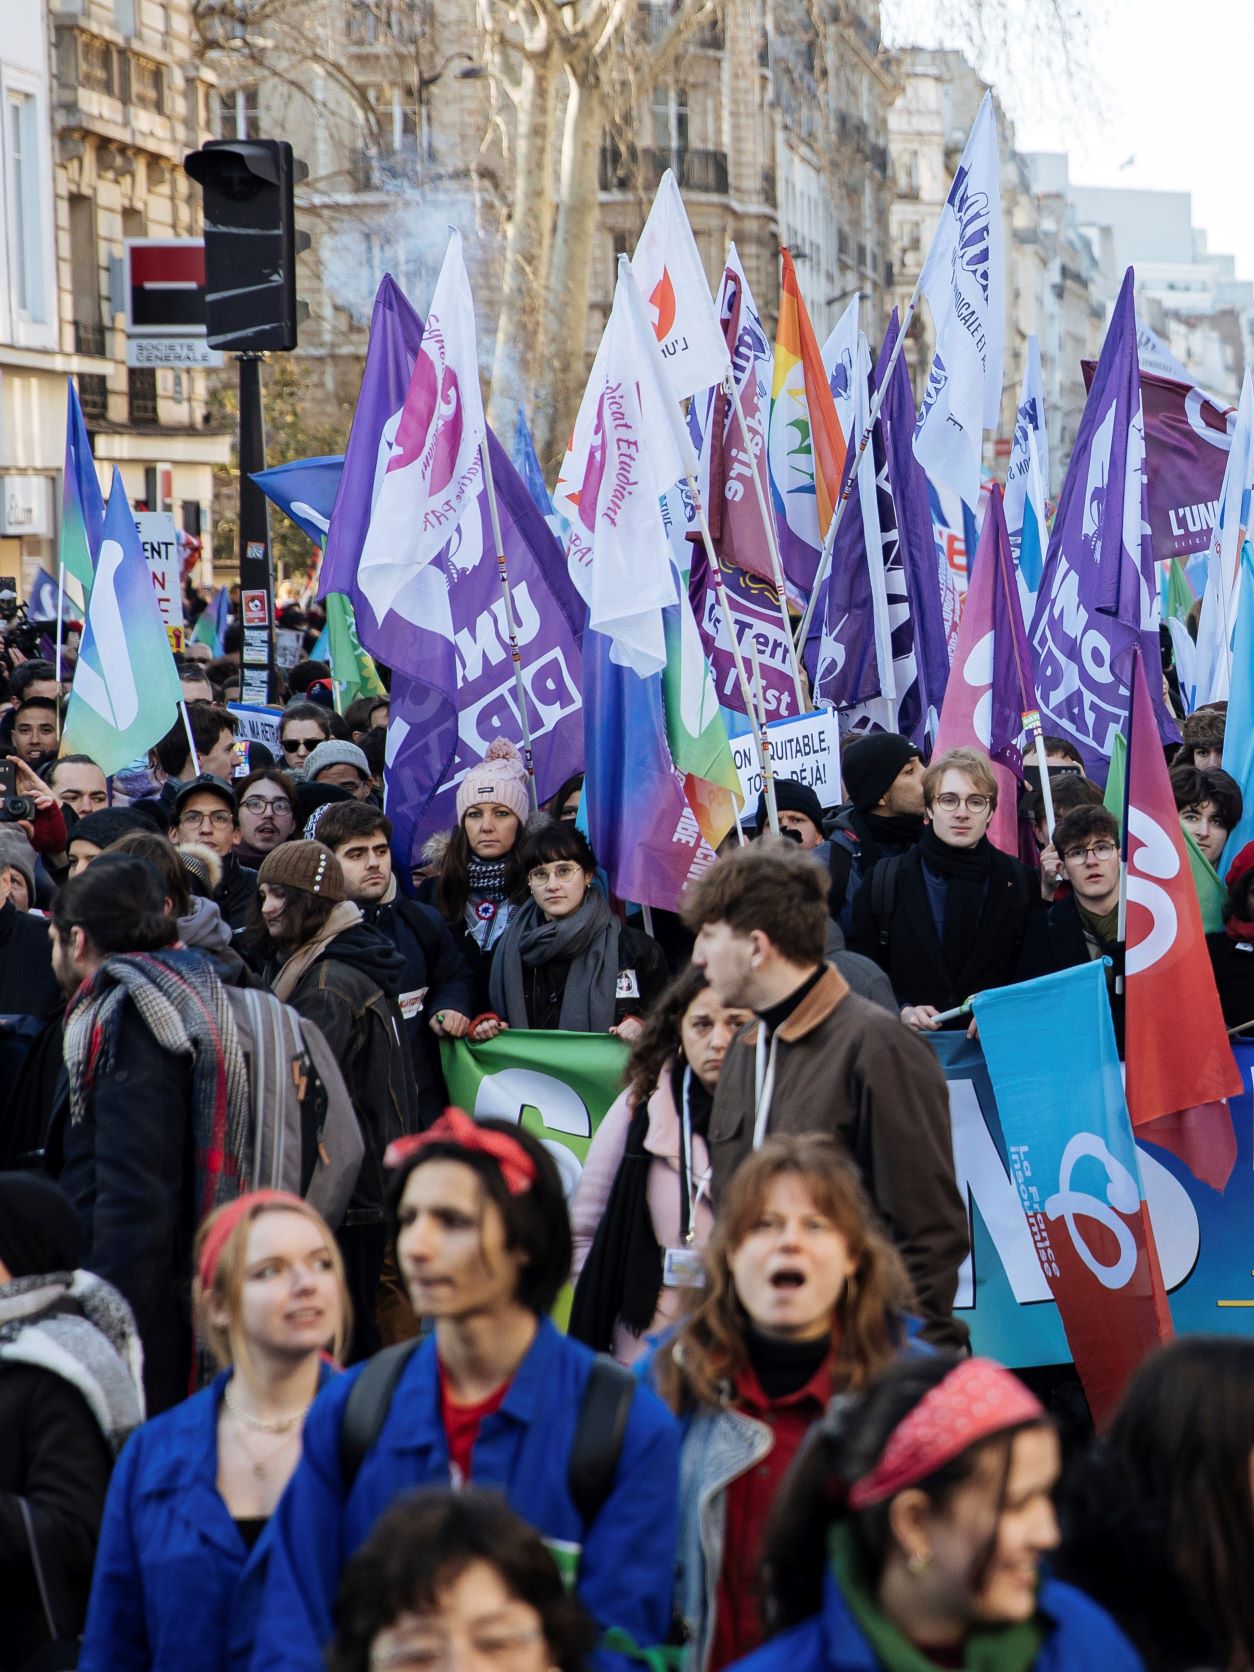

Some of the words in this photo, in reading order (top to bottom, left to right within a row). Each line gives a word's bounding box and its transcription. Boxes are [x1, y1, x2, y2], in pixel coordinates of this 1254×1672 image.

[769, 730, 831, 762] QUITABLE,
[1010, 1145, 1053, 1278] insoumise
[1019, 1145, 1032, 1177] La
[1028, 1185, 1061, 1278] France
